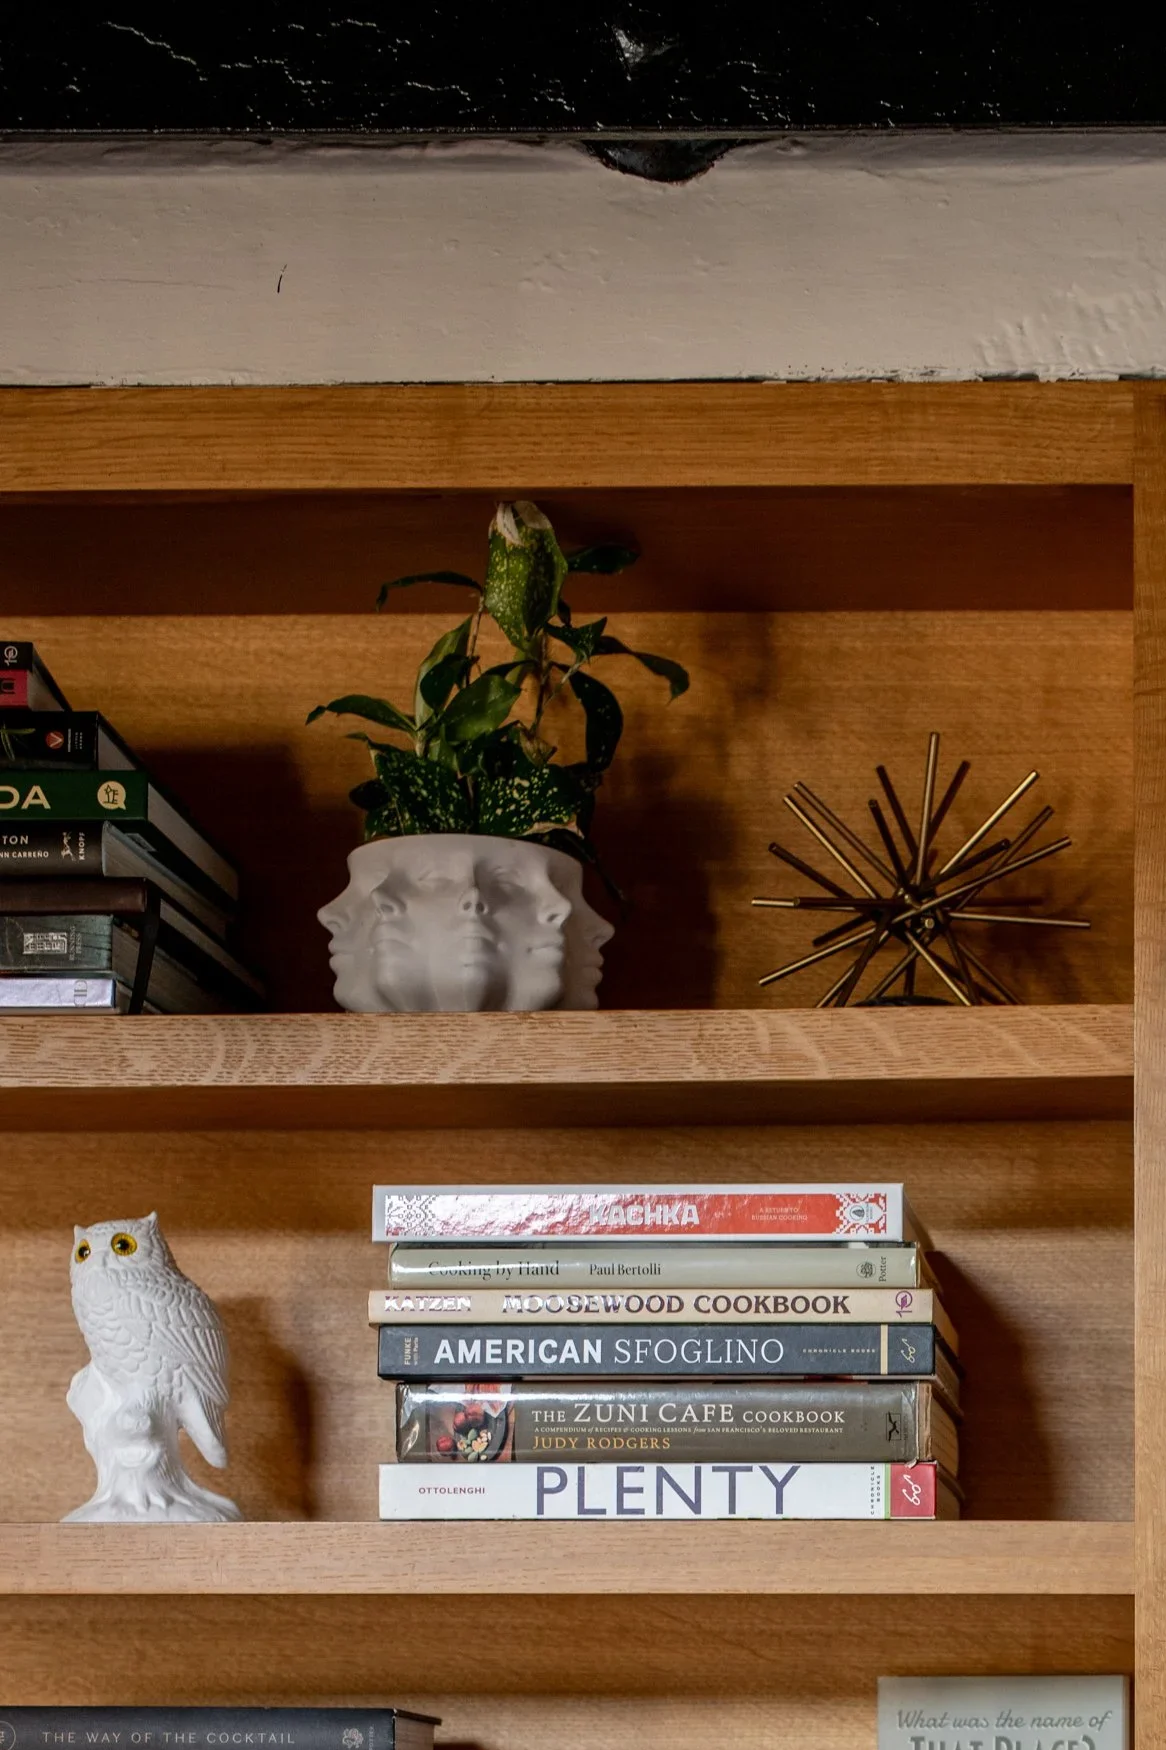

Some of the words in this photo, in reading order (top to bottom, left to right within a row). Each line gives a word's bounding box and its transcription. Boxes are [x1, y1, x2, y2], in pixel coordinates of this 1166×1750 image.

[2, 834, 29, 845] TON
[12, 849, 49, 859] CARREÑO
[589, 1203, 700, 1226] KACHKA
[428, 1260, 492, 1281] Cooking
[496, 1260, 512, 1281] by
[518, 1260, 560, 1276] Hand
[589, 1263, 615, 1276] Paul
[617, 1263, 661, 1276] Bertolli
[879, 1256, 887, 1282] Potter
[384, 1295, 472, 1312] KATZEN
[502, 1295, 685, 1314] MOOSEWOOD
[693, 1295, 851, 1314] COOKBOOK
[404, 1337, 412, 1366] FUNKE
[433, 1338, 602, 1365] AMERICAN
[614, 1338, 784, 1365] SFOGLINO
[531, 1410, 566, 1422] THE
[574, 1403, 649, 1424] ZUNI
[658, 1403, 734, 1423] CAFE
[742, 1410, 845, 1423] COOKBOOK
[533, 1436, 578, 1449] JUDY
[587, 1437, 671, 1449] RODGERS
[418, 1487, 486, 1495] OTTOLENGHI
[536, 1466, 801, 1515] PLENTY
[897, 1709, 949, 1728] What
[952, 1716, 989, 1728] was
[994, 1709, 1026, 1728] the
[1030, 1716, 1084, 1729] name
[1089, 1710, 1113, 1731] of
[42, 1732, 76, 1743] THE
[86, 1732, 121, 1743] WAY
[131, 1732, 152, 1743] OF
[164, 1732, 197, 1743] THE
[206, 1732, 295, 1744] COCKTAIL
